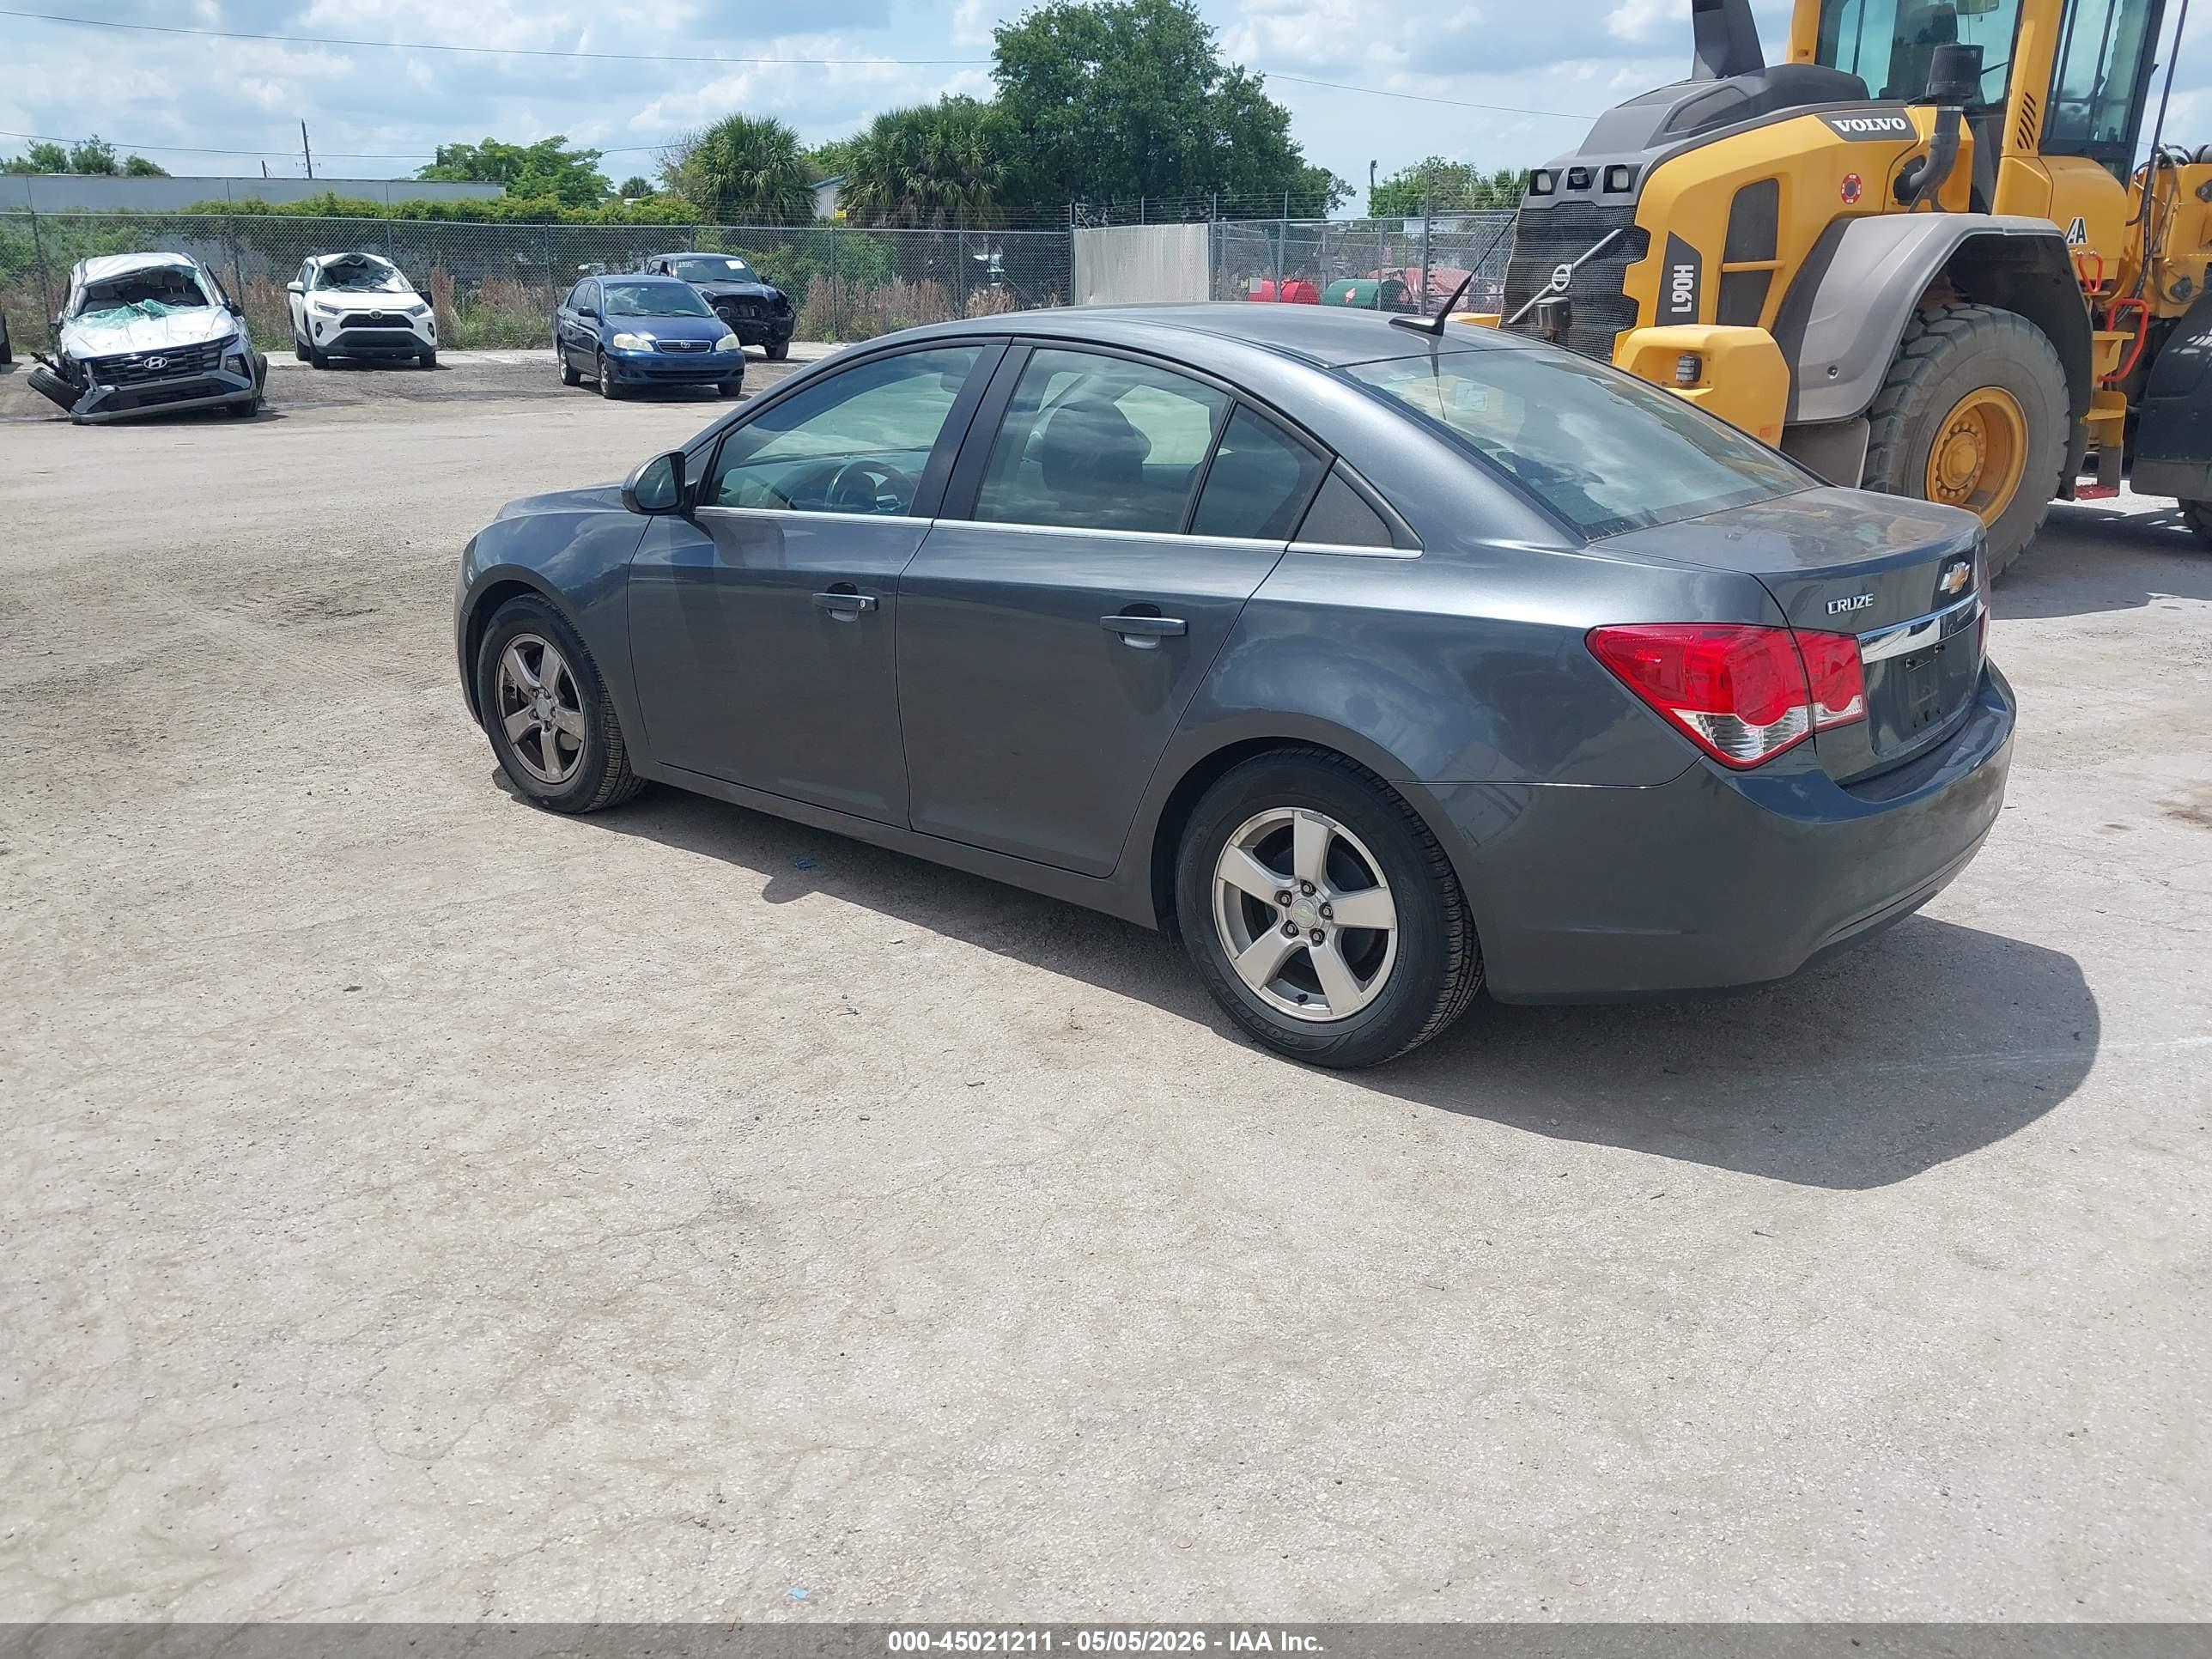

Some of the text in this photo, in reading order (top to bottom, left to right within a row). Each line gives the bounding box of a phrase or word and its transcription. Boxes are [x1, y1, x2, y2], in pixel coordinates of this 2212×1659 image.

[1831, 117, 1907, 132] VOLVO
[1671, 264, 1694, 313] L90H
[1826, 592, 1875, 615] CRUZE
